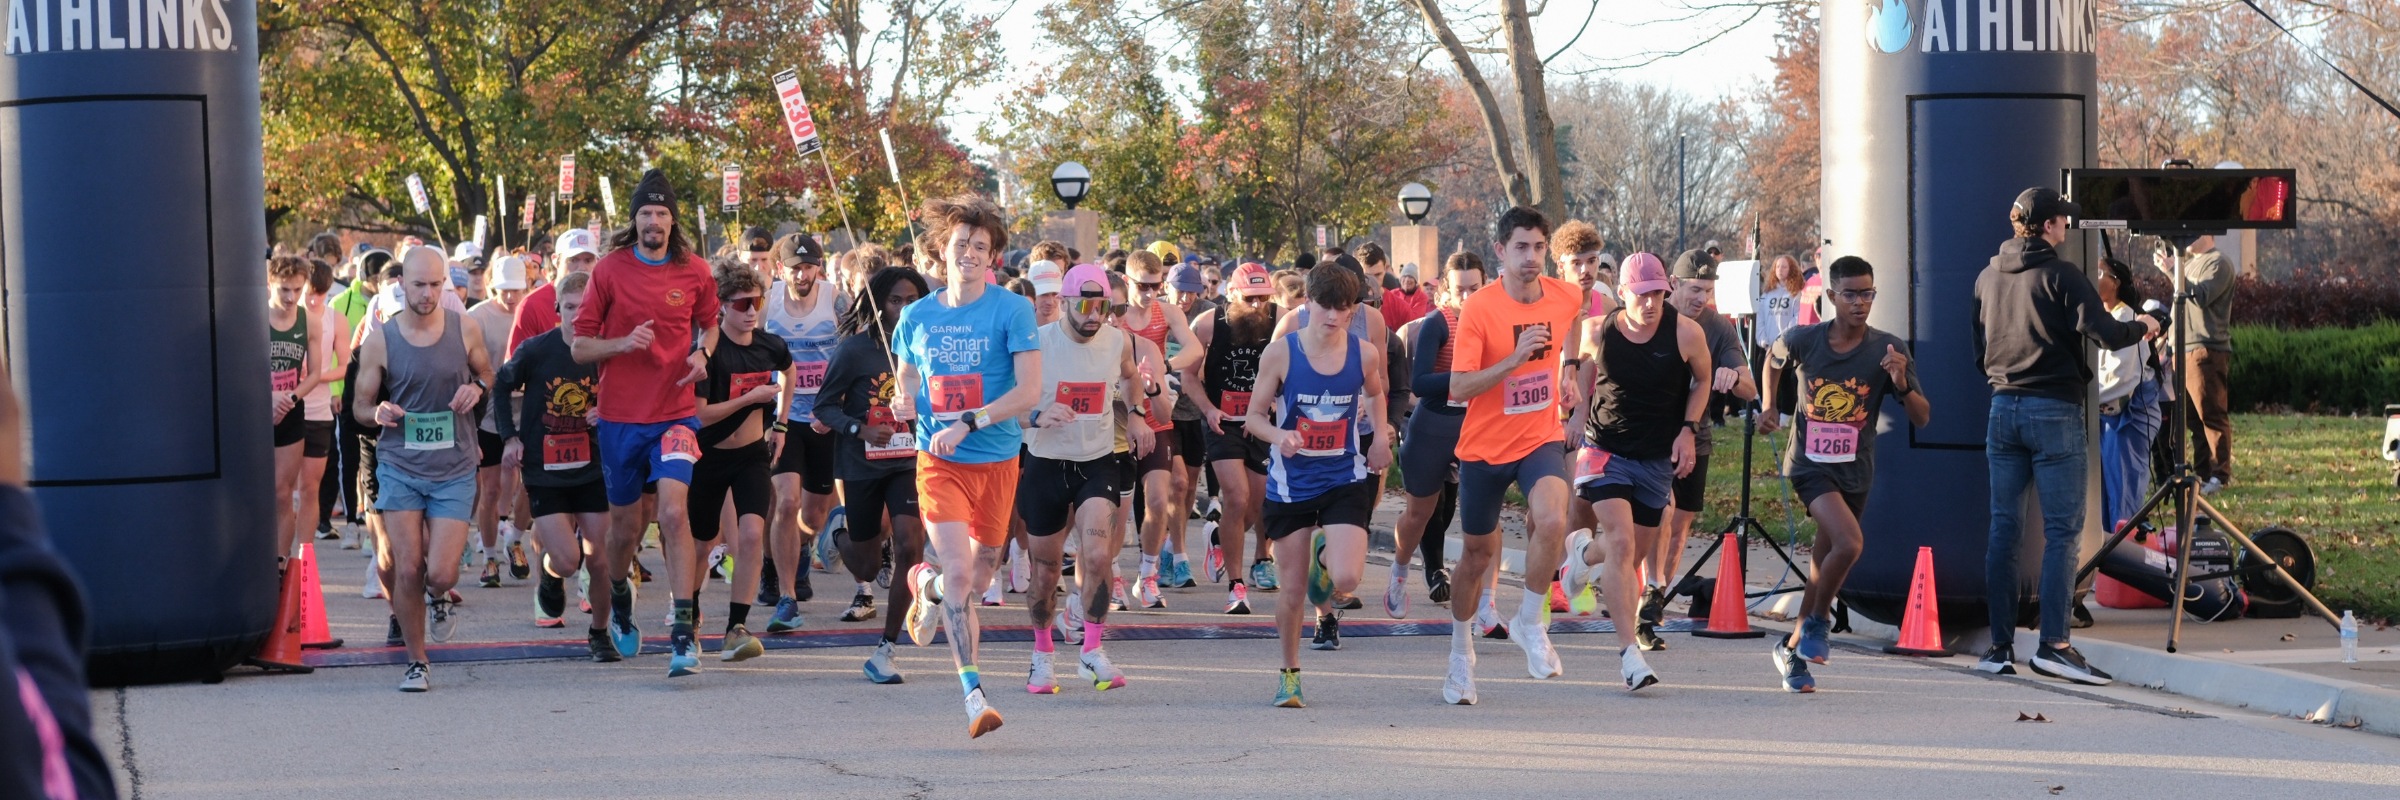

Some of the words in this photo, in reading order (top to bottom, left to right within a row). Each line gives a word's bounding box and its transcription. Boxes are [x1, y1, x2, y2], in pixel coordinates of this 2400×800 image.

[6, 0, 232, 54] ATHLINKS
[1921, 0, 2096, 52] ATHLINKS
[782, 84, 815, 138] 1:30
[561, 164, 574, 192] 1:40
[726, 175, 739, 203] 1:40
[1769, 297, 1790, 309] 913
[930, 325, 972, 334] GARMIN
[941, 336, 990, 352] Smart
[928, 348, 982, 366] Pacing
[795, 374, 822, 388] 156
[944, 393, 965, 411] 73
[1297, 394, 1317, 404] PONY
[1321, 394, 1352, 404] EXPRESS
[1512, 386, 1549, 406] 1309
[1071, 397, 1090, 413] 85
[416, 427, 443, 442] 826
[1306, 436, 1336, 449] 159
[672, 439, 696, 454] 264
[1813, 438, 1851, 454] 1266
[555, 448, 580, 463] 141
